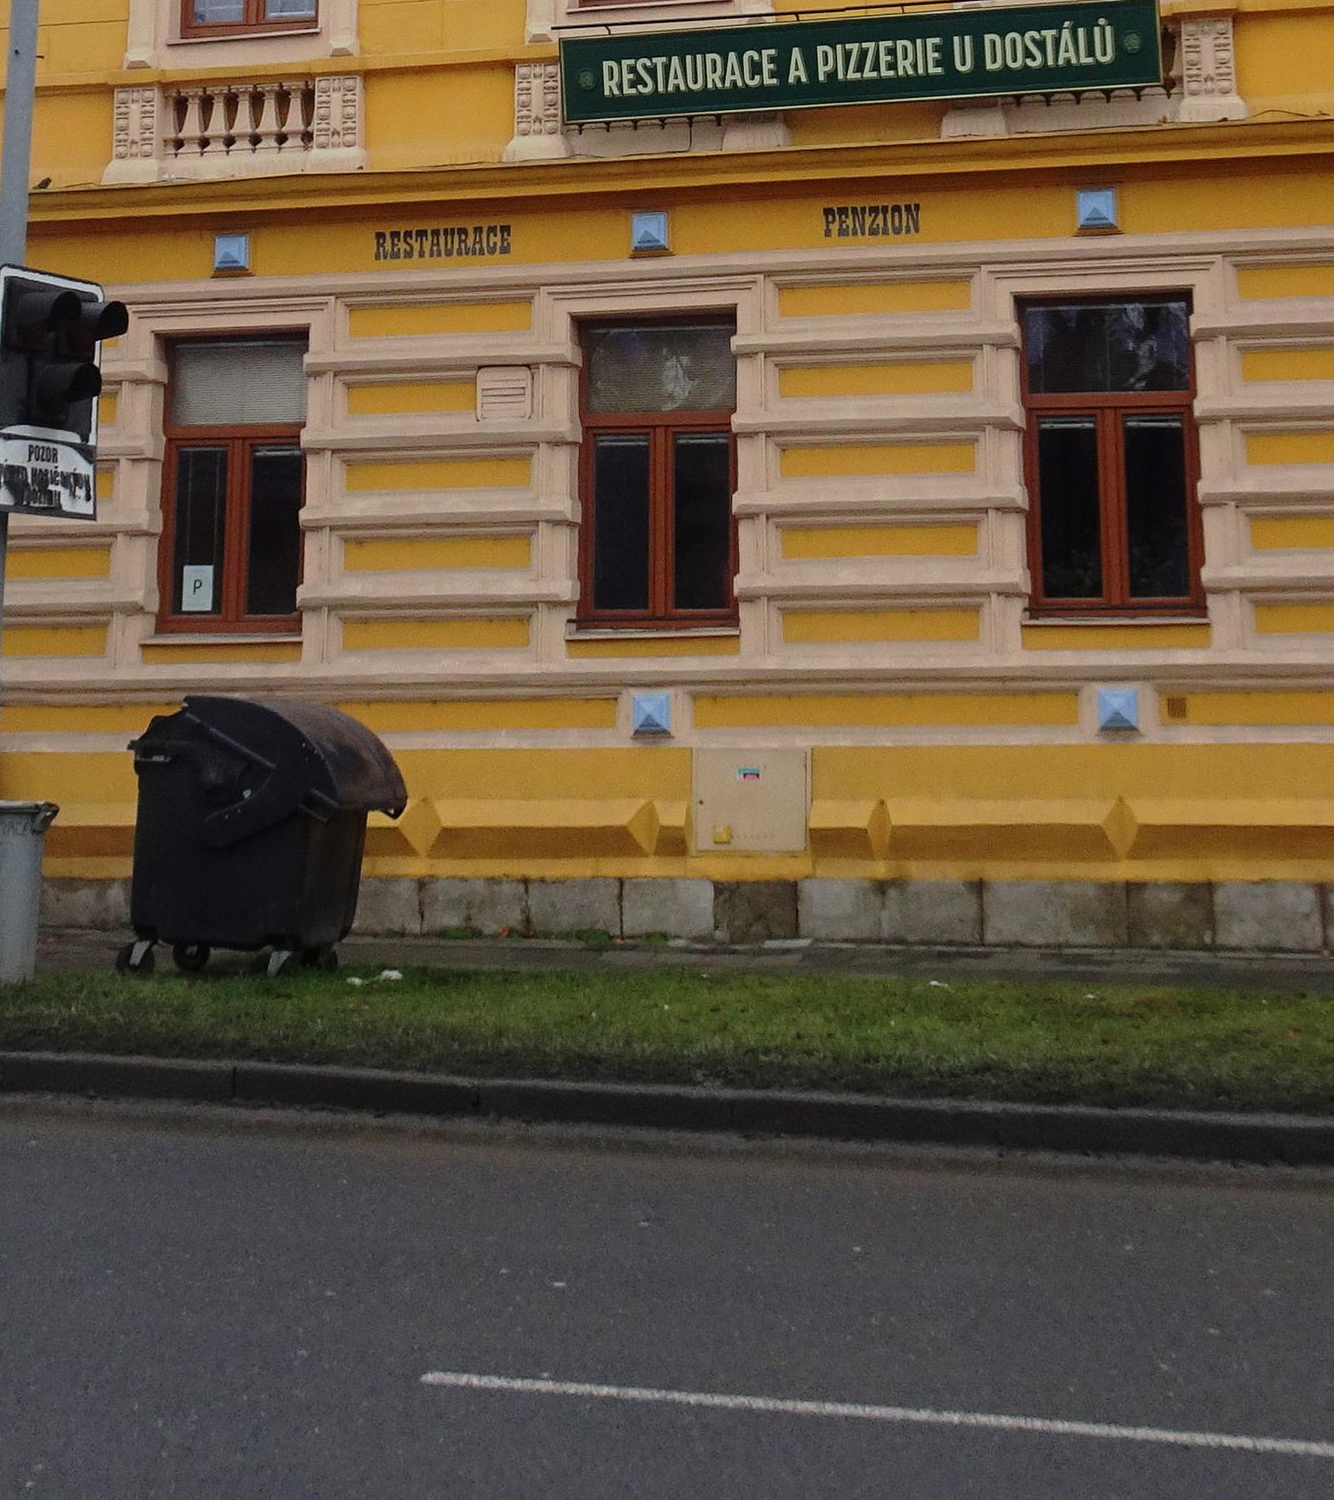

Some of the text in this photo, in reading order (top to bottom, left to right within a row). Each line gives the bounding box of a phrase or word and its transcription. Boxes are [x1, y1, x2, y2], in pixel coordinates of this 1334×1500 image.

[602, 17, 1116, 97] RESTAURACE A PIZZERIE U DOSTÁLŮ
[822, 203, 921, 238] PENZION
[374, 224, 512, 261] RESTAURACE
[27, 444, 59, 464] POZOR
[193, 578, 203, 595] P
